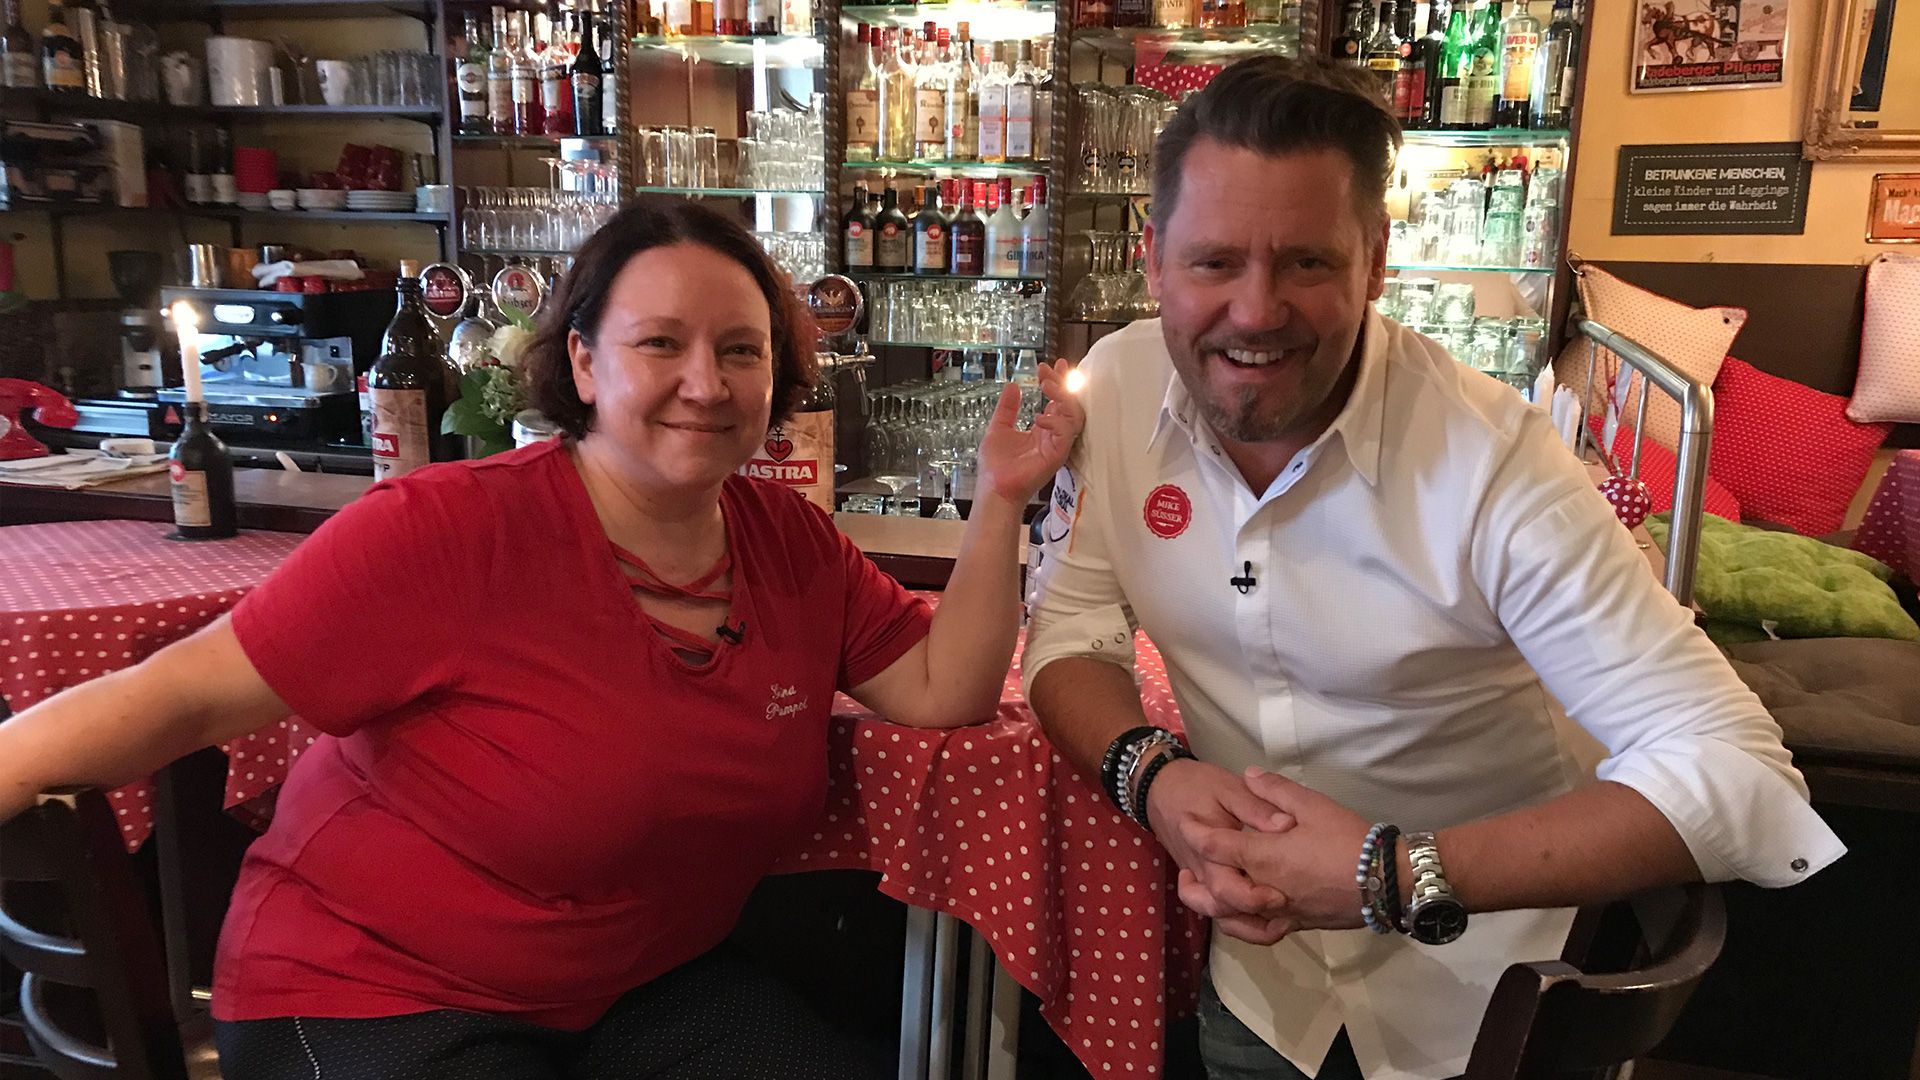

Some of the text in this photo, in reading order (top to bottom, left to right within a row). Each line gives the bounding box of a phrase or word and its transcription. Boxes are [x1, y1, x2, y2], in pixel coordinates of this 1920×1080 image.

[1724, 61, 1779, 74] Pilsner
[1644, 167, 1786, 181] BETRUNKENE MENSCHEN,
[1633, 184, 1790, 198] kleine Kinder und Leggings
[1642, 200, 1778, 214] sagen immer die Wahrheit
[748, 463, 814, 480] ASTRA
[1156, 499, 1180, 511] MIKE
[1150, 508, 1184, 524] SÜSSER
